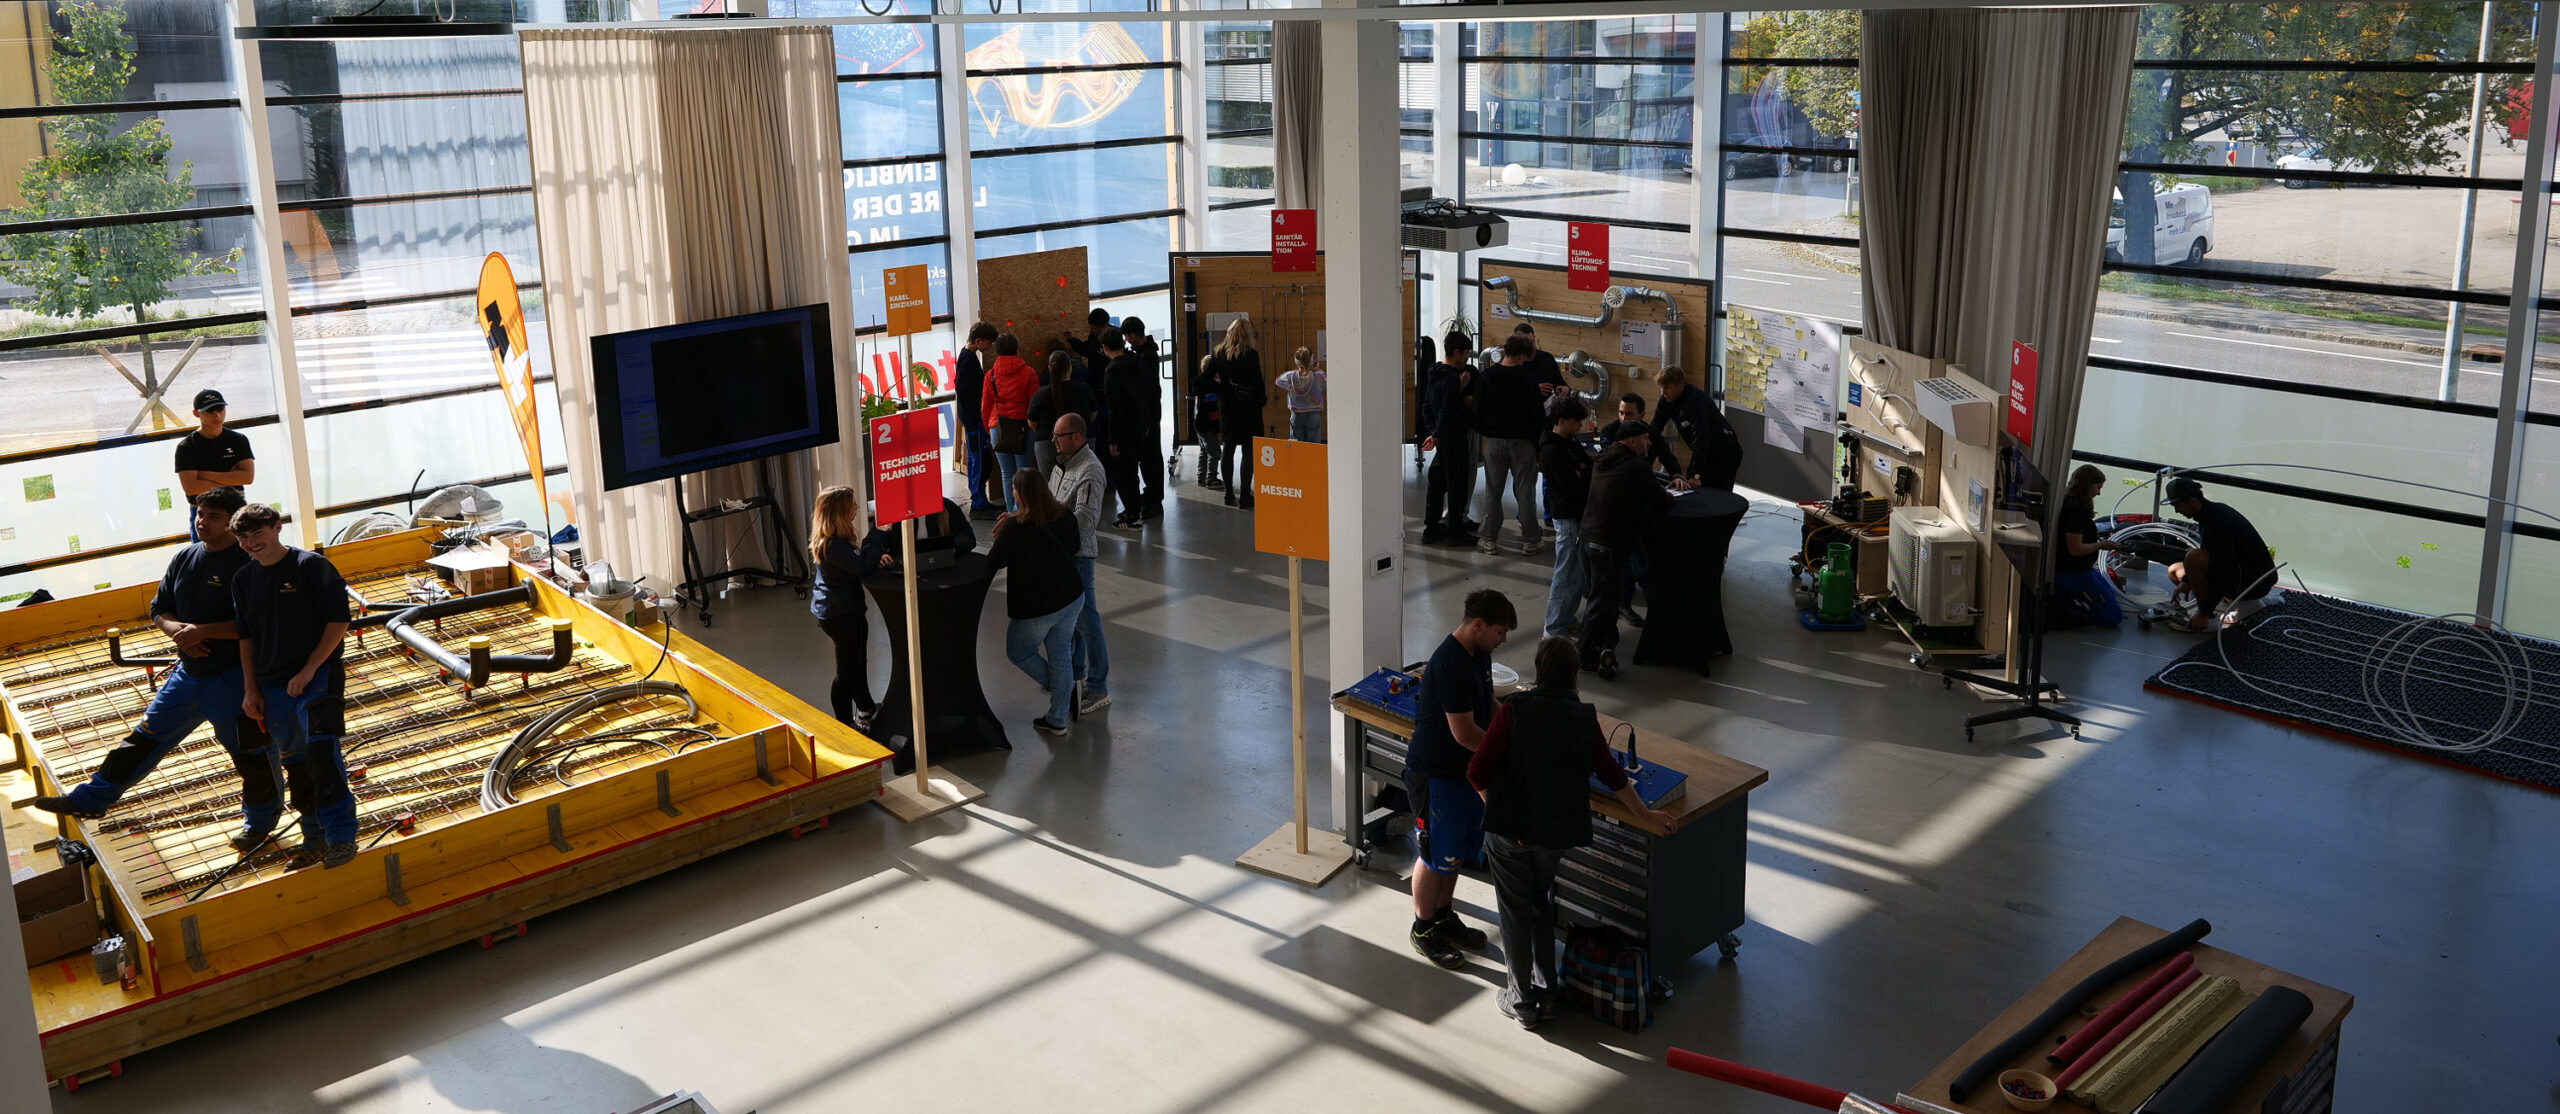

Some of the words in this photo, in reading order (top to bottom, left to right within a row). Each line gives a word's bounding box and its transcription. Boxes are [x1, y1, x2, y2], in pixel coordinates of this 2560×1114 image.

[1275, 213, 1285, 226] 4
[1275, 233, 1303, 241] SANITÄR
[1571, 226, 1579, 239] 5
[1571, 249, 1593, 257] KLIMA-
[1571, 264, 1598, 272] TECHNIK
[887, 272, 897, 286] 3
[889, 294, 910, 303] KABEL
[890, 299, 924, 310] EINZIEHEN
[2013, 347, 2020, 366] 6
[878, 423, 892, 445] 2
[879, 450, 939, 471] TECHNISCHE
[1261, 445, 1275, 467] 8
[880, 464, 927, 483] PLANUNG
[1260, 484, 1303, 499] MESSEN
